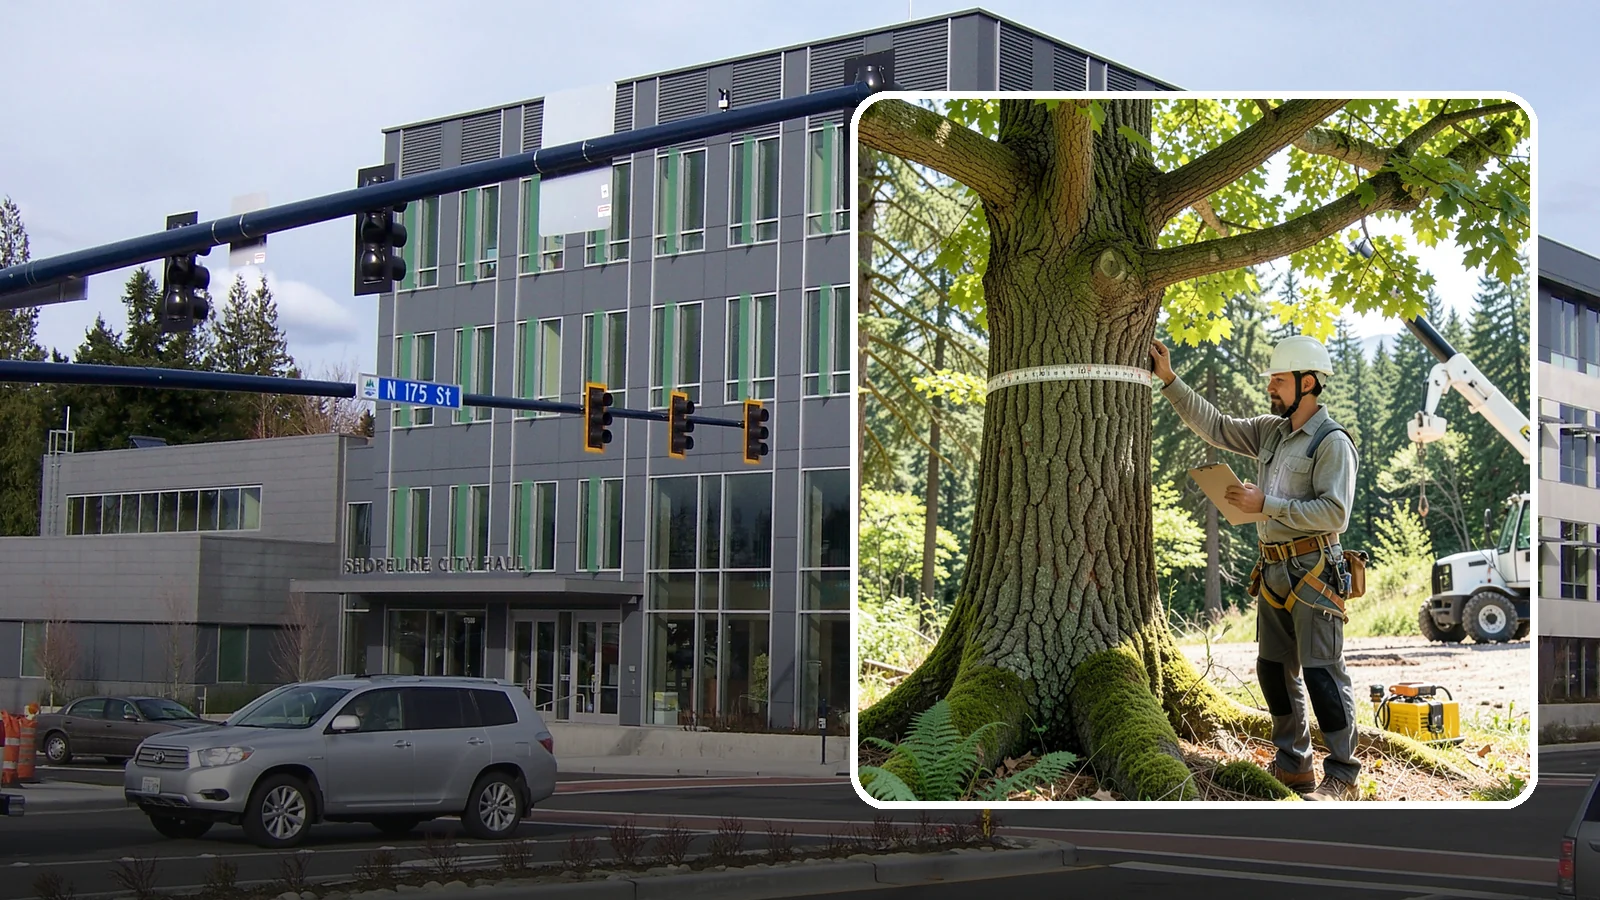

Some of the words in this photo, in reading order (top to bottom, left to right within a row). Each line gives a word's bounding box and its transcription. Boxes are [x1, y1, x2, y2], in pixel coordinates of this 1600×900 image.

[387, 380, 396, 399] N
[405, 382, 427, 403] 175
[436, 386, 451, 406] St
[344, 556, 432, 574] SHORELINE
[438, 556, 476, 571] CITY
[484, 555, 526, 571] HALL
